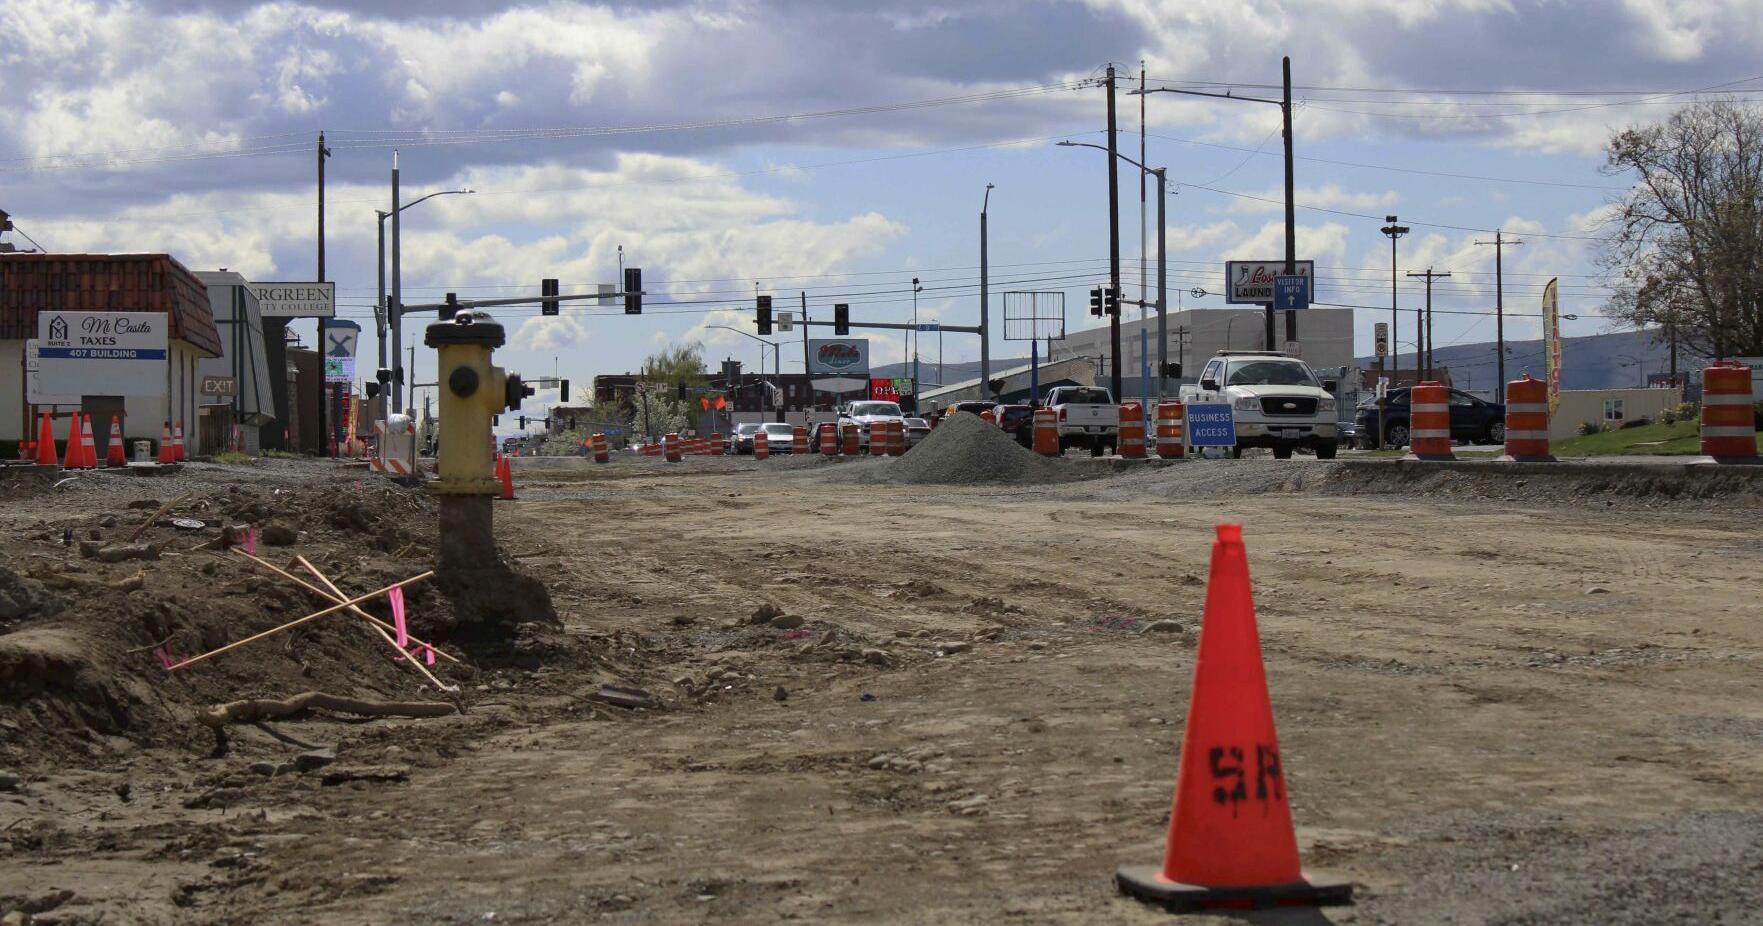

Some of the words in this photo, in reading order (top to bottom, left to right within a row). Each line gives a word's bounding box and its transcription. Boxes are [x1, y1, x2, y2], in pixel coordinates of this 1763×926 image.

[1277, 278, 1304, 286] VISITOR
[257, 288, 330, 301] RGREEN
[1235, 287, 1272, 297] LAUND
[281, 303, 329, 311] COLLEGE
[81, 316, 110, 334] Mi
[114, 317, 152, 335] Casita
[80, 336, 117, 346] TAXES
[69, 349, 87, 357] 407
[90, 349, 137, 358] BUILDING
[205, 380, 233, 393] EXIT
[1189, 413, 1230, 422] BUSINESS
[1195, 428, 1228, 437] ACCESS
